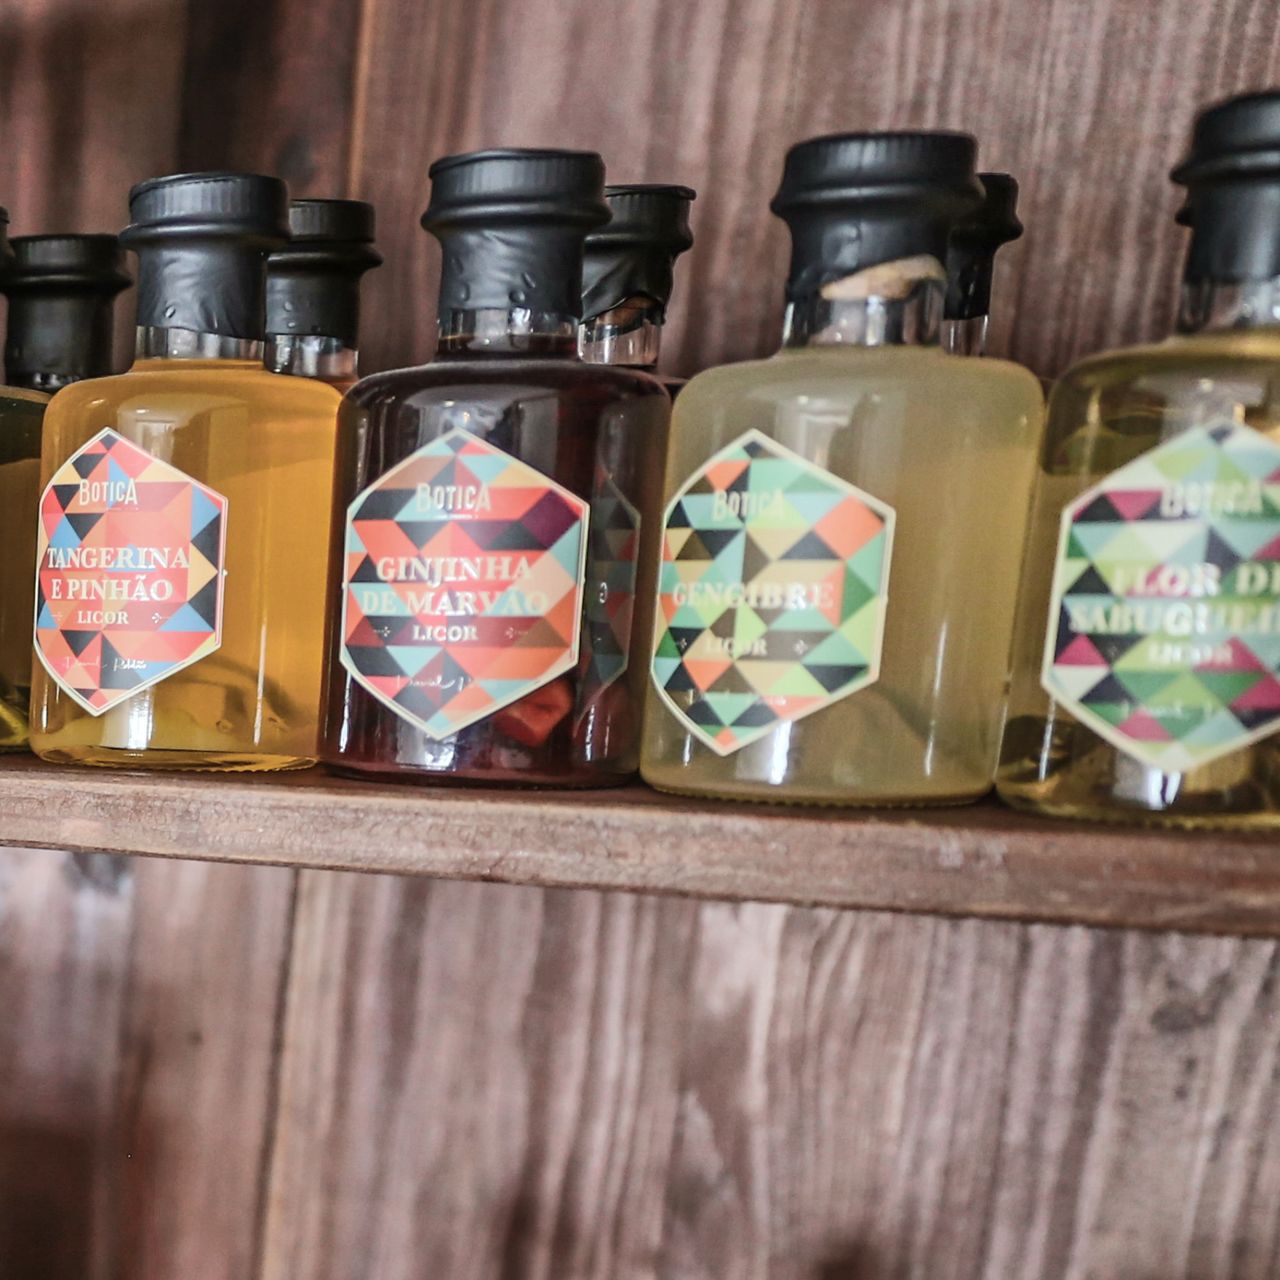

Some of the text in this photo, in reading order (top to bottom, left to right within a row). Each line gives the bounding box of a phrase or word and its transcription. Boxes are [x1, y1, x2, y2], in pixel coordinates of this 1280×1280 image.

[79, 478, 138, 506] BOTICA
[416, 482, 492, 513] BOTICA
[47, 546, 191, 570] TANGERINA
[375, 555, 534, 588] GINJINHA
[51, 574, 173, 601] E PINHÃO
[362, 590, 398, 614] DE
[77, 610, 130, 625] LICOR
[412, 624, 479, 642] LICOR
